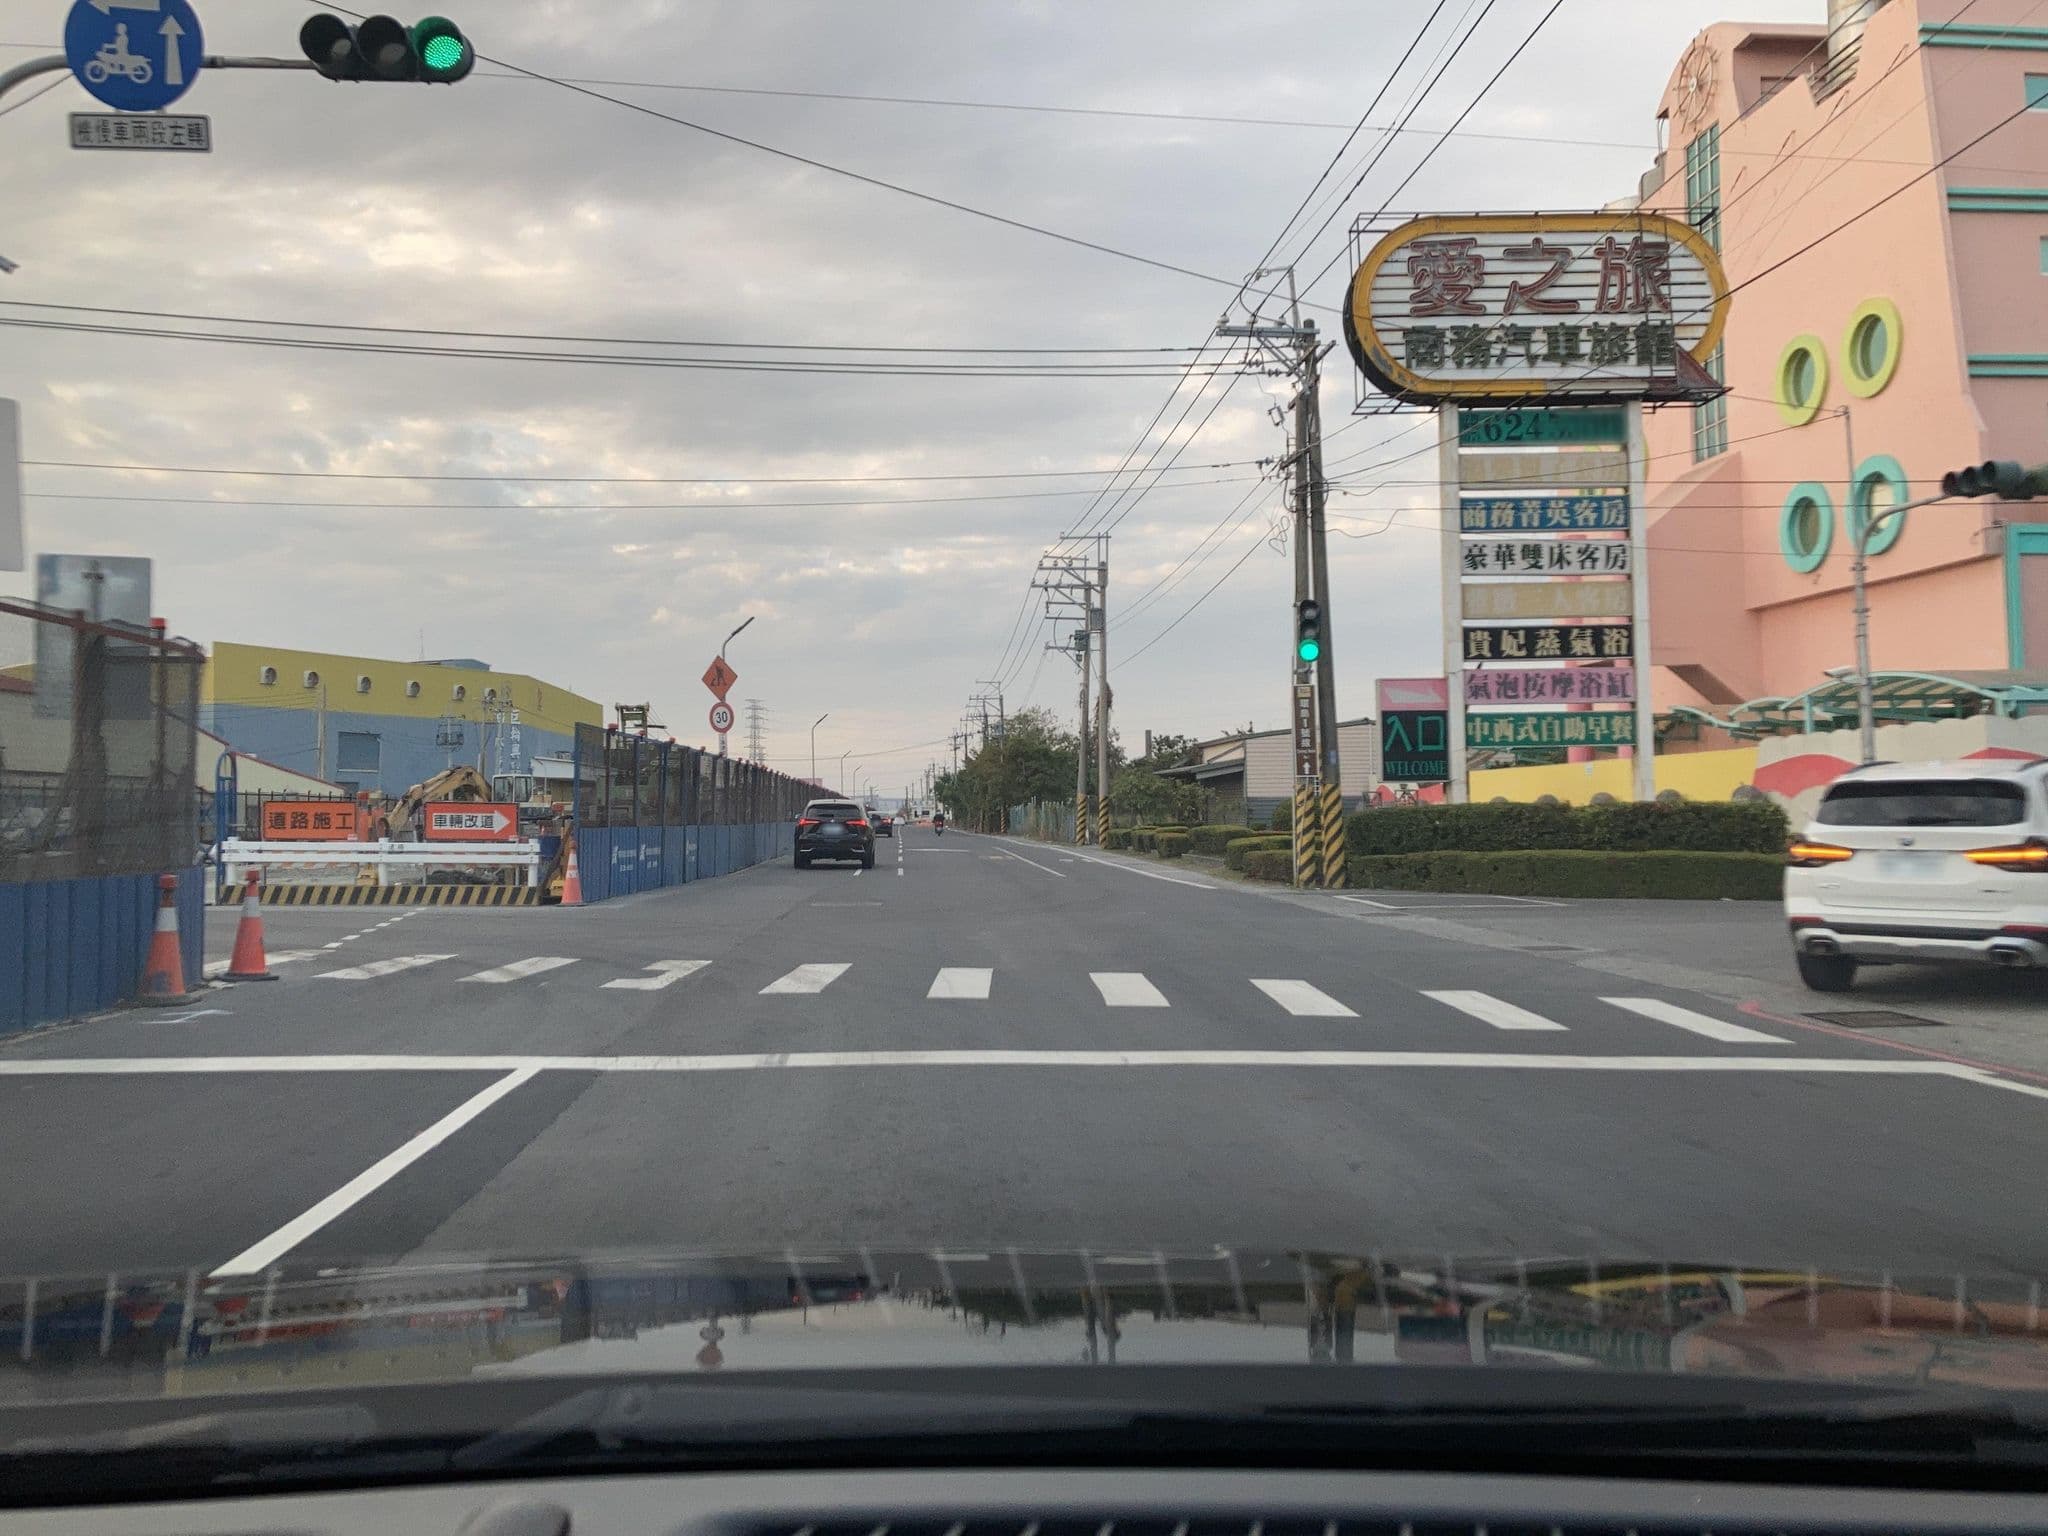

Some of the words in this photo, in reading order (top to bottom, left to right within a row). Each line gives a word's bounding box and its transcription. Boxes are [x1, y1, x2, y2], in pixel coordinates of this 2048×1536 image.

[1407, 236, 1672, 316] 愛之旅
[1402, 320, 1676, 369] 商務汽車旅館
[1464, 543, 1629, 571] 豪華雙床客房
[1467, 626, 1631, 658] 貴妃蒸氣浴
[1466, 671, 1633, 701] 氣泡按摩浴缸
[715, 711, 728, 724] 30
[1384, 714, 1445, 753] 入口
[1385, 760, 1448, 777] WELCOME
[268, 811, 353, 830] 道路施工
[434, 814, 494, 829] 車輛改道
